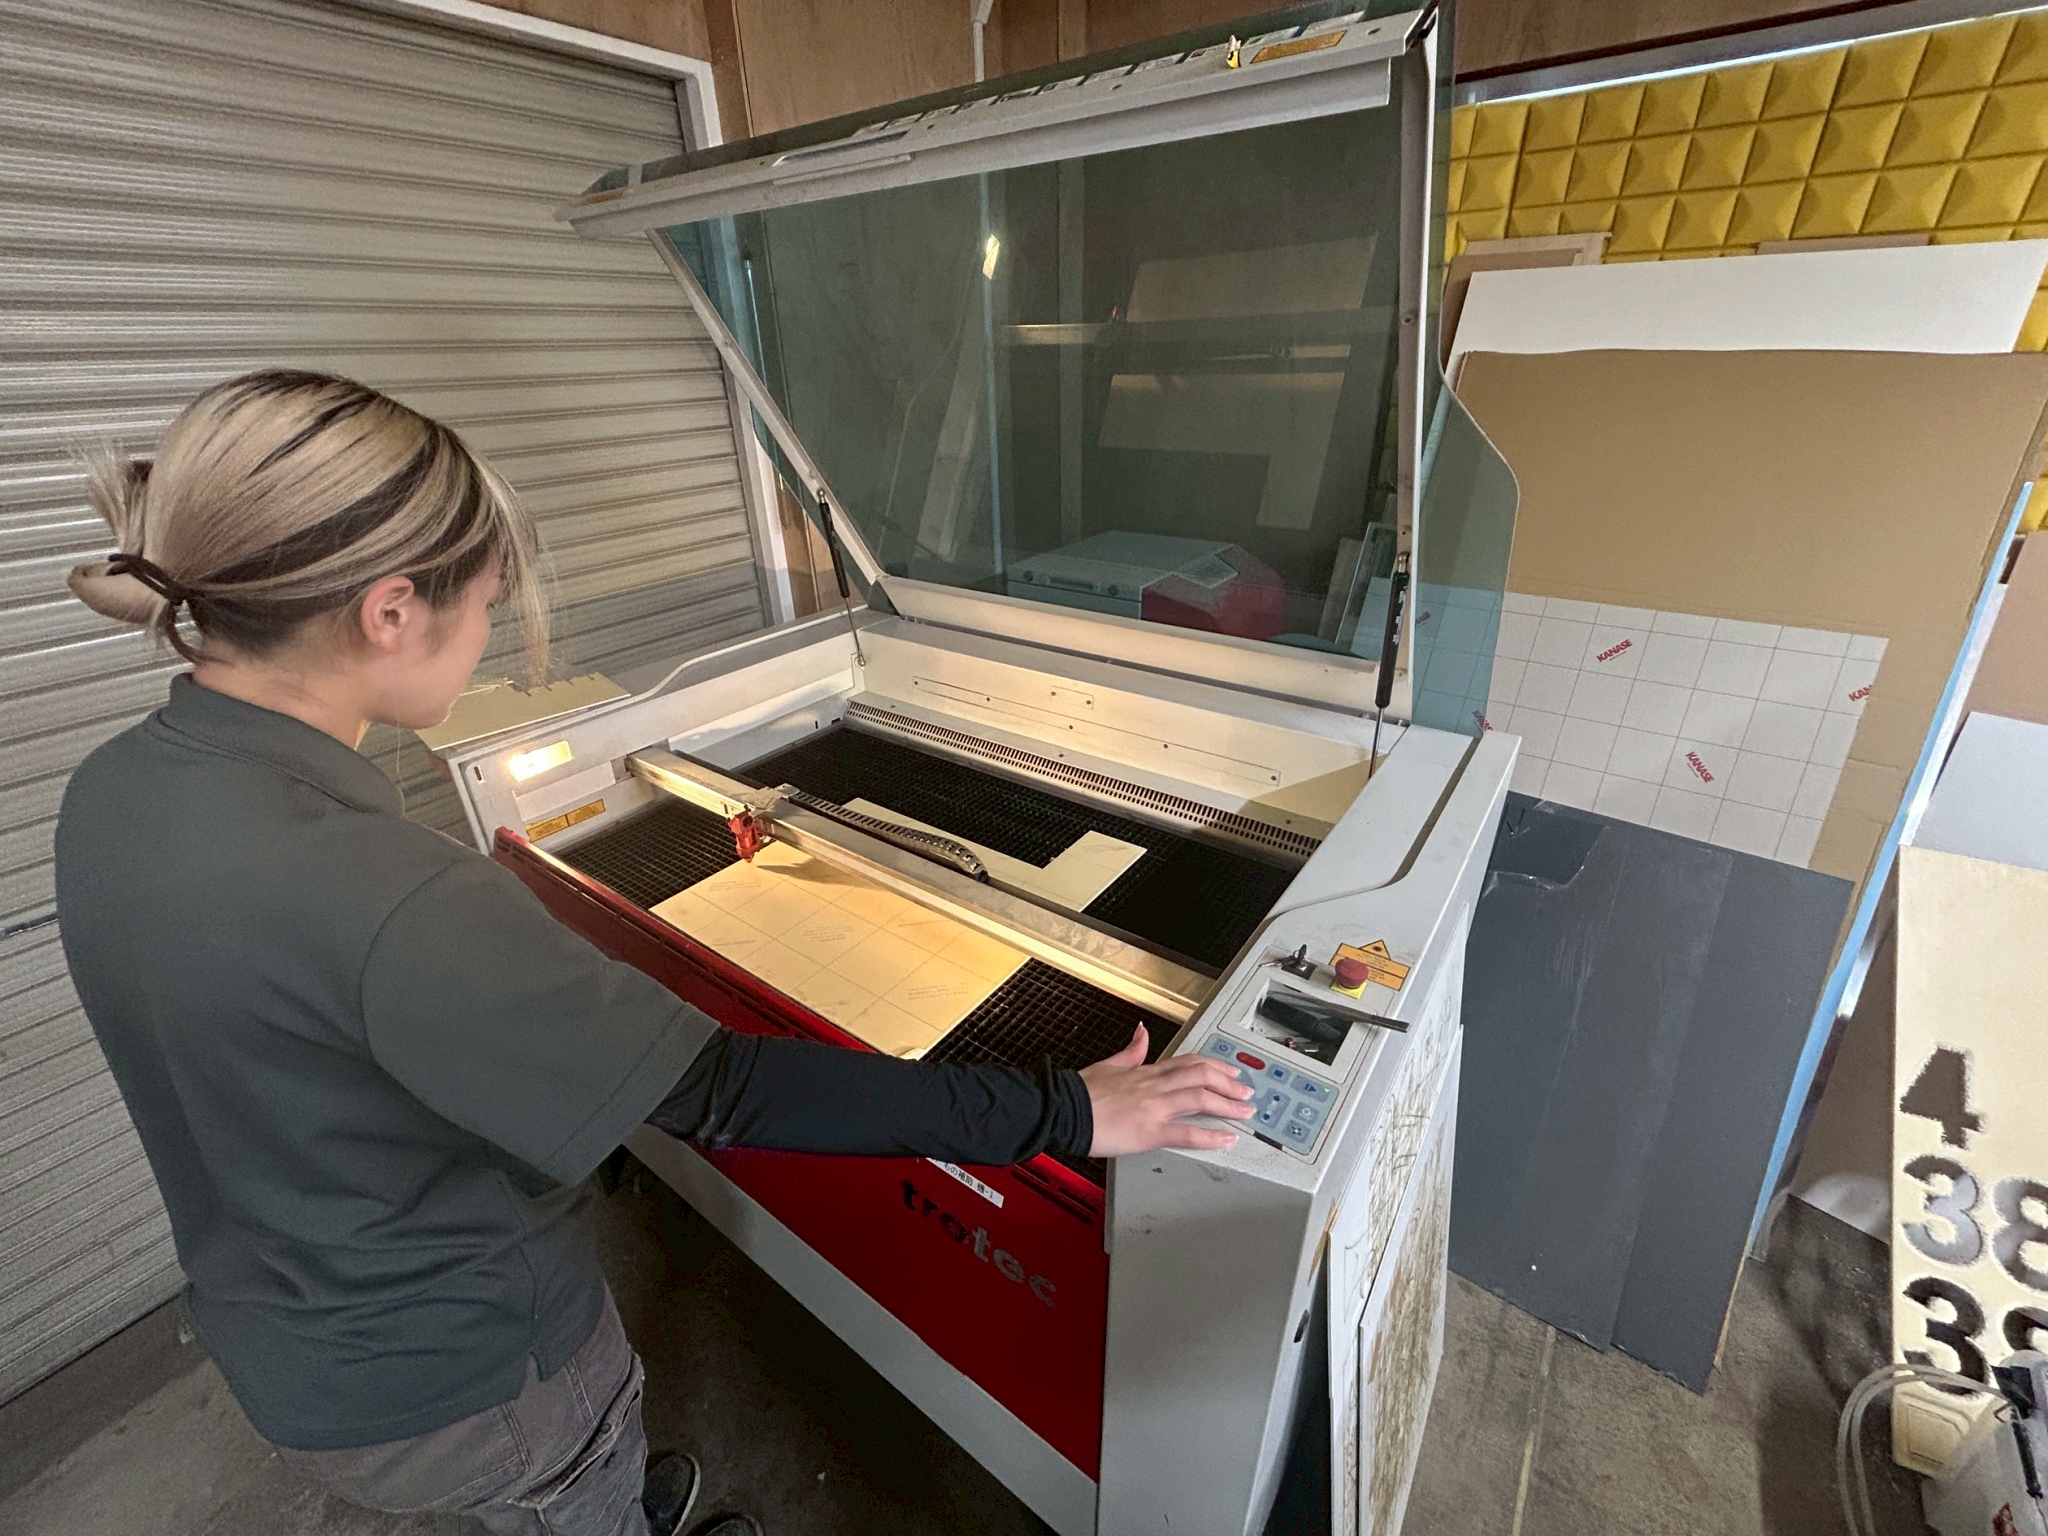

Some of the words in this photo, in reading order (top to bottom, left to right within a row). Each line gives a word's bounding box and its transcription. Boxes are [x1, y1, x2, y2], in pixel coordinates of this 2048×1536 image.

[1596, 639, 1633, 663] KANASE
[1685, 751, 1715, 784] KANASE
[1899, 1048, 1984, 1149] 4
[902, 1179, 1058, 1308] trotec
